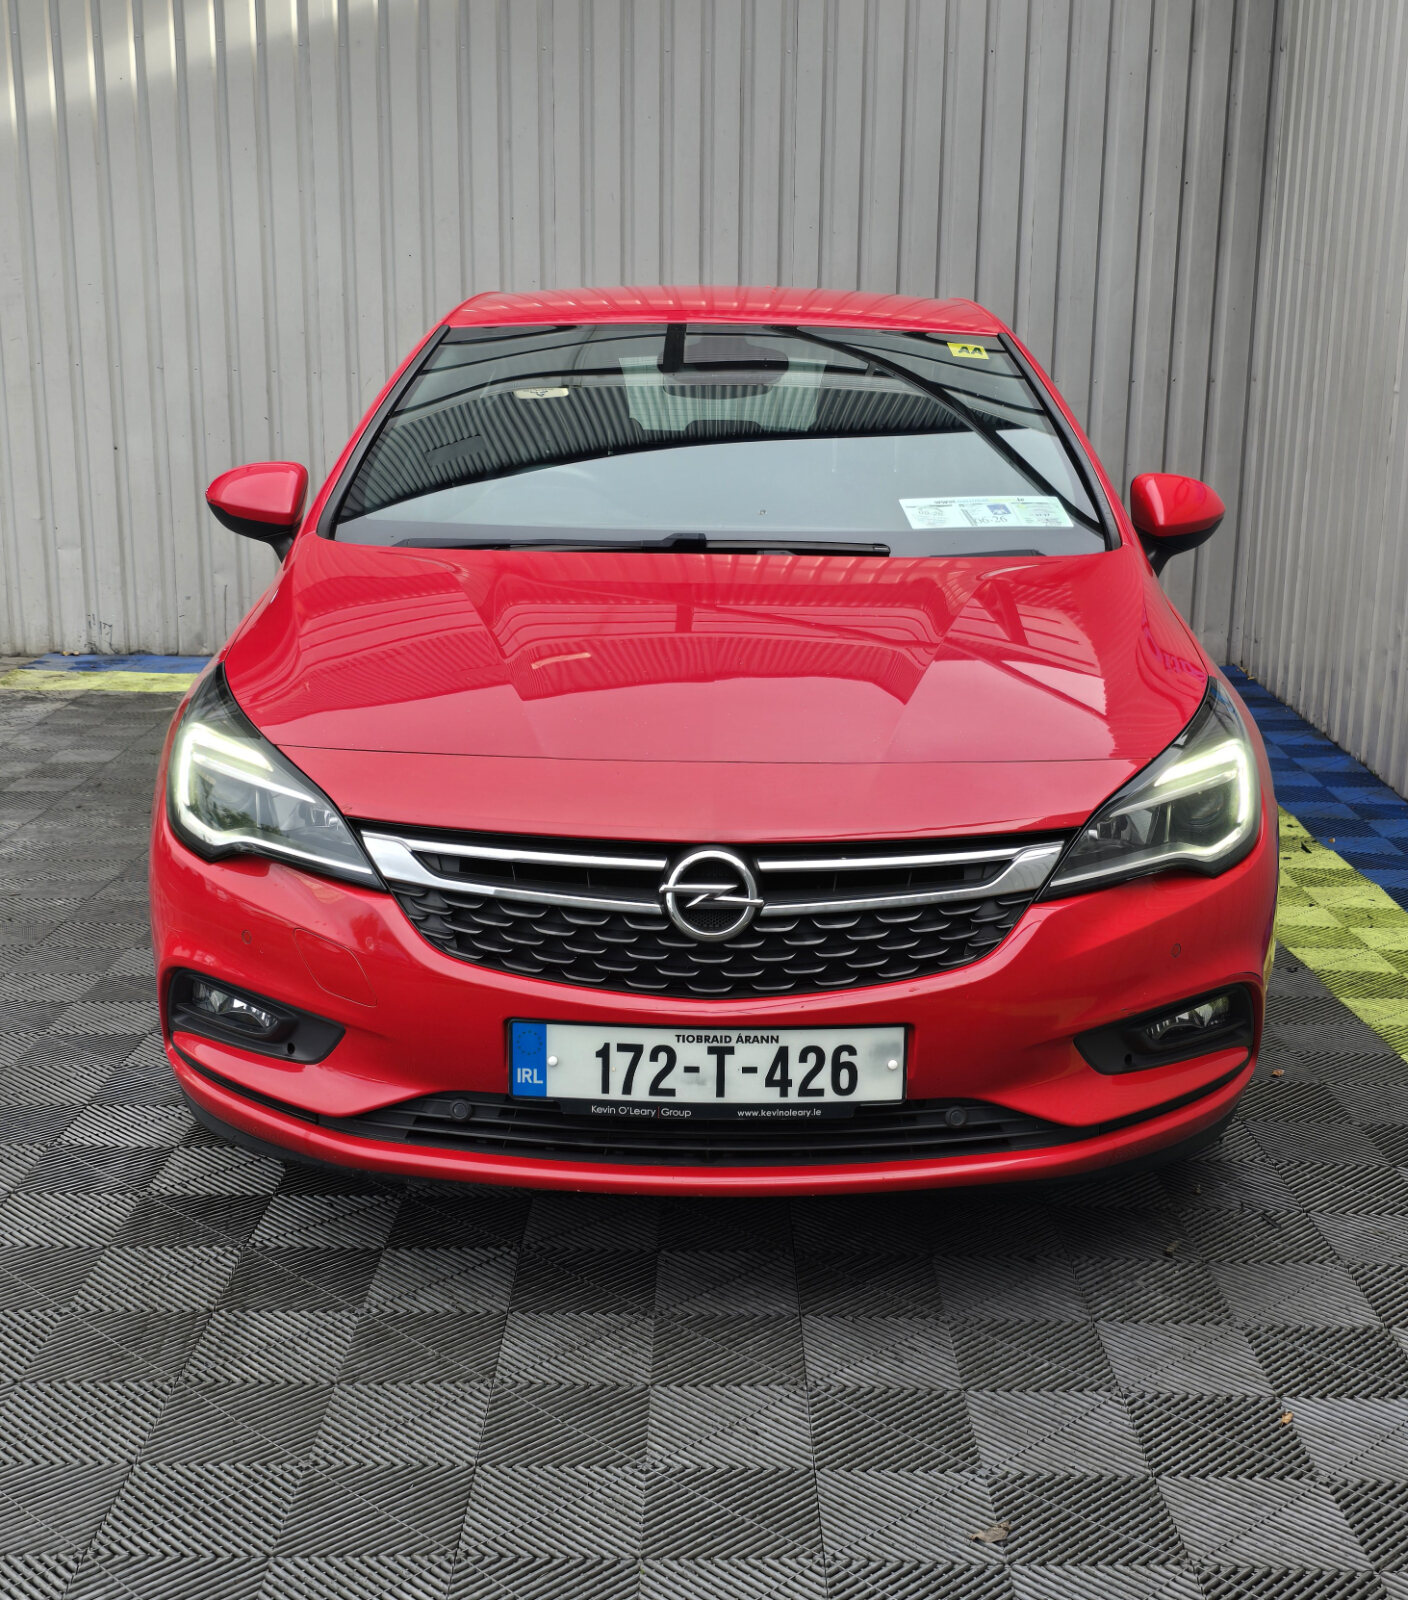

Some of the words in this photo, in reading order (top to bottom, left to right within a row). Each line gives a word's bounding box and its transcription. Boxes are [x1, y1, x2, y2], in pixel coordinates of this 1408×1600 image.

[958, 346, 983, 355] AA
[675, 1034, 732, 1044] TIOBRAID
[735, 1033, 780, 1044] ÁRANN
[517, 1067, 544, 1084] IRL
[595, 1042, 858, 1098] 172-T-426
[591, 1105, 616, 1114] Kevin
[618, 1106, 656, 1117] O'Leary
[661, 1107, 692, 1118] Group
[737, 1108, 822, 1118] www.kevinoleary.ie
